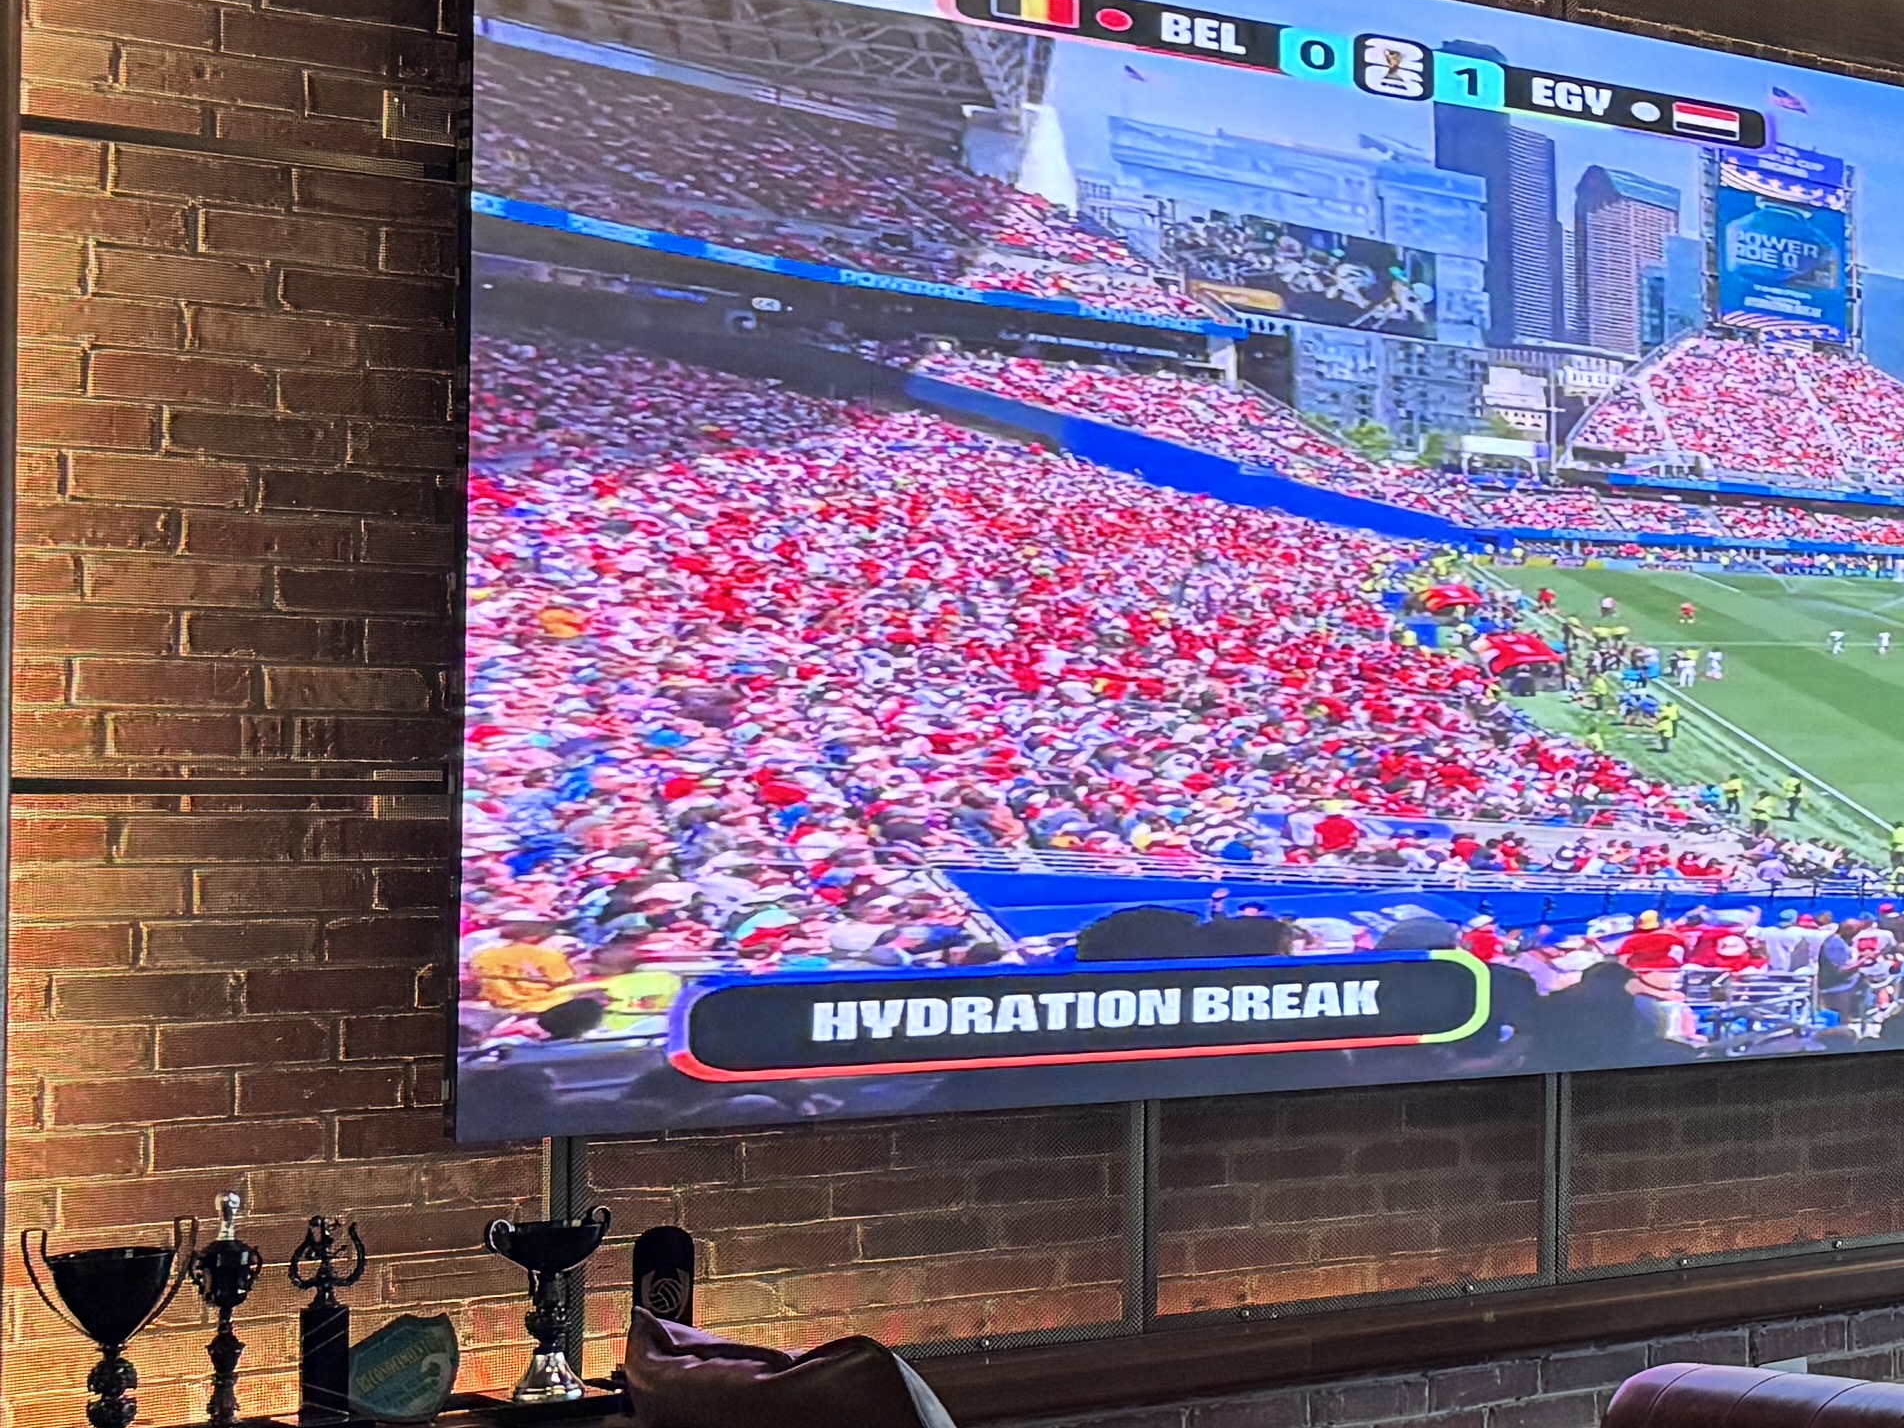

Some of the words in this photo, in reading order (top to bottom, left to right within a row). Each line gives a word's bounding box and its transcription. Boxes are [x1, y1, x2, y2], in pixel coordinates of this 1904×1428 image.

[1161, 11, 1248, 58] BEL
[1301, 37, 1334, 73] 0
[1456, 65, 1482, 98] 1
[1531, 76, 1614, 120] EGY
[812, 986, 1188, 1042] HYDRATION
[1191, 979, 1381, 1025] BREAK
